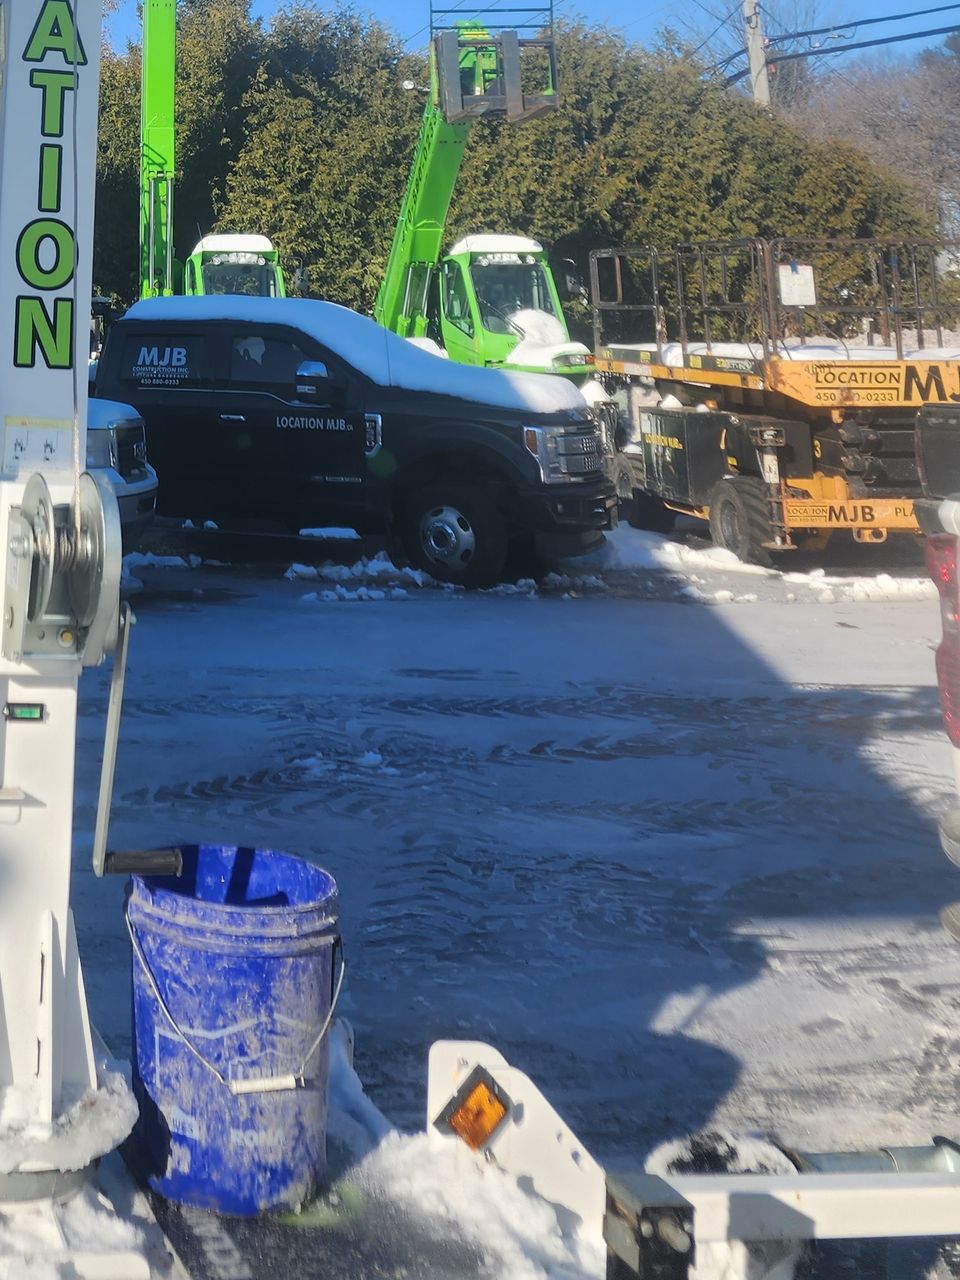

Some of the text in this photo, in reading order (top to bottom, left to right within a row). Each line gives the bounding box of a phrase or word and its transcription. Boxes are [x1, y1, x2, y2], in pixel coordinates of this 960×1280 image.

[137, 346, 187, 367] MJB
[815, 371, 901, 385] LOCATION
[815, 392, 894, 402] 450 0-0233
[276, 416, 323, 430] LOCATION
[787, 507, 828, 515] LOCAION
[828, 505, 875, 523] MJB
